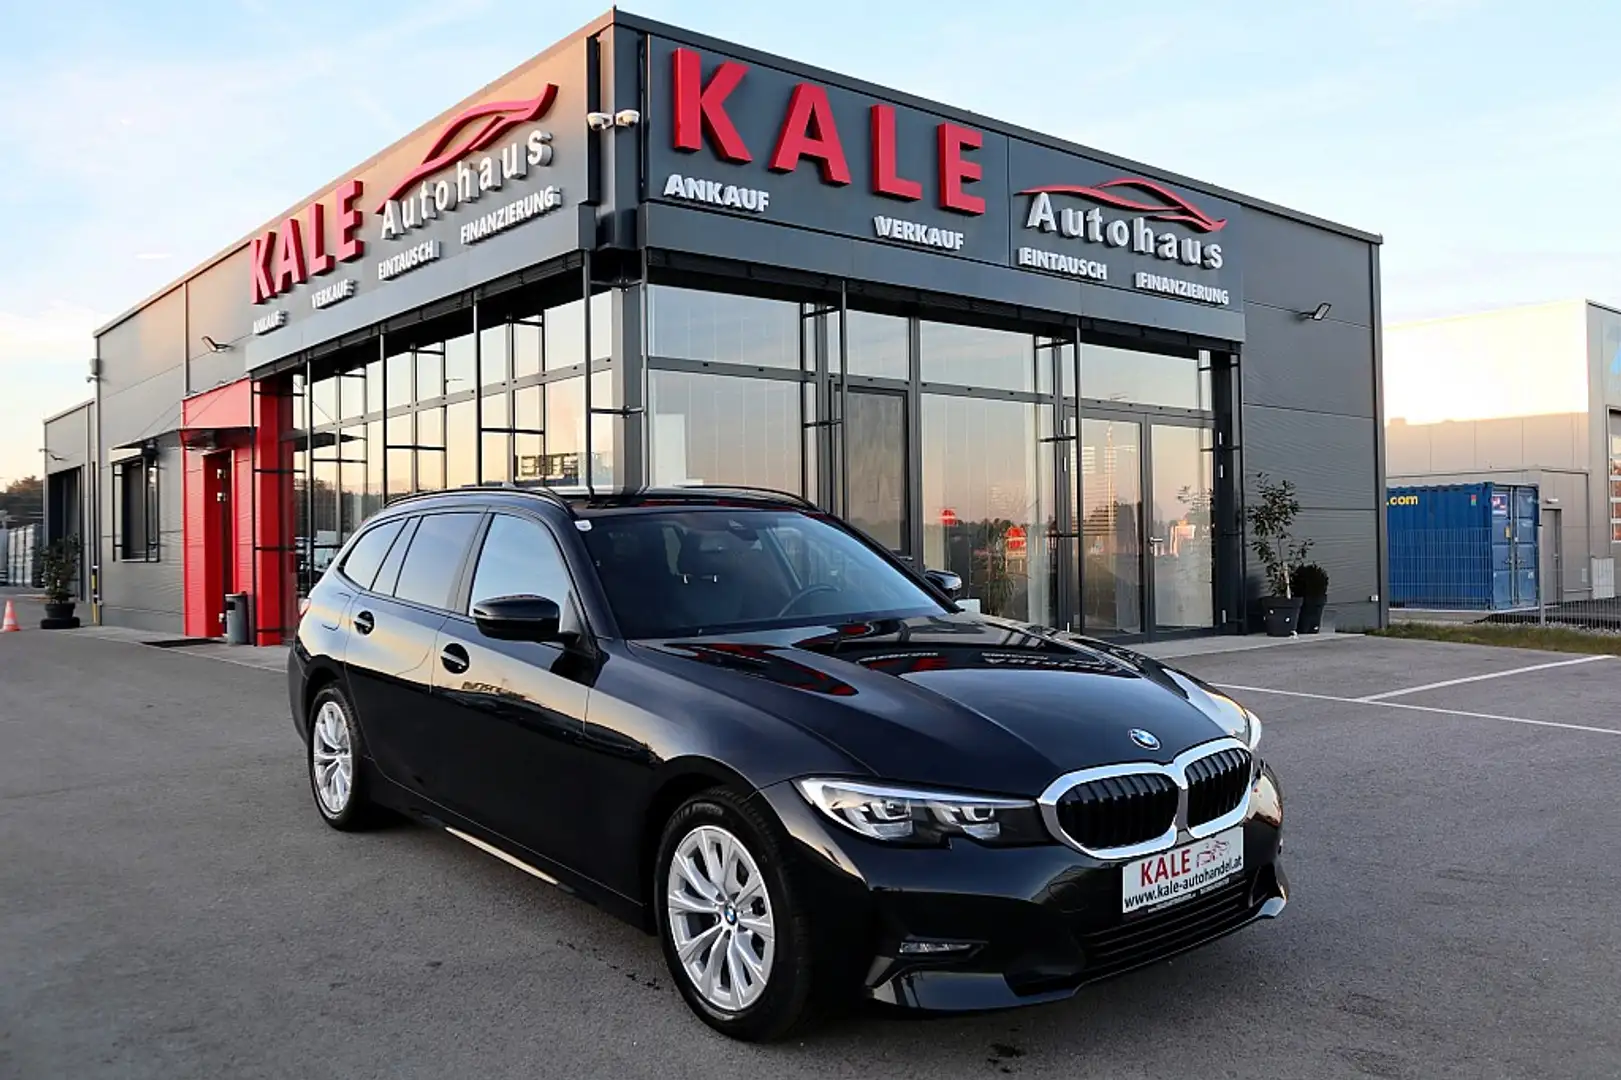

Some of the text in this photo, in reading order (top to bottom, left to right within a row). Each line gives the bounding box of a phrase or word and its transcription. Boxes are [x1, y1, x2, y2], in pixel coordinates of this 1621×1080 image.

[250, 129, 553, 305] KALE Autohaus
[672, 47, 1224, 269] KALE Autohaus
[311, 278, 356, 310] VERKAUF
[378, 240, 442, 282] EINTAUSCH
[460, 185, 563, 245] FINANZIERUNG
[664, 174, 1230, 306] ANKAUF VERKAUF EINTAUSCH FINANZIERUNG
[1124, 855, 1242, 909] www.kale-autohandel.at
[1141, 849, 1191, 887] KALE
